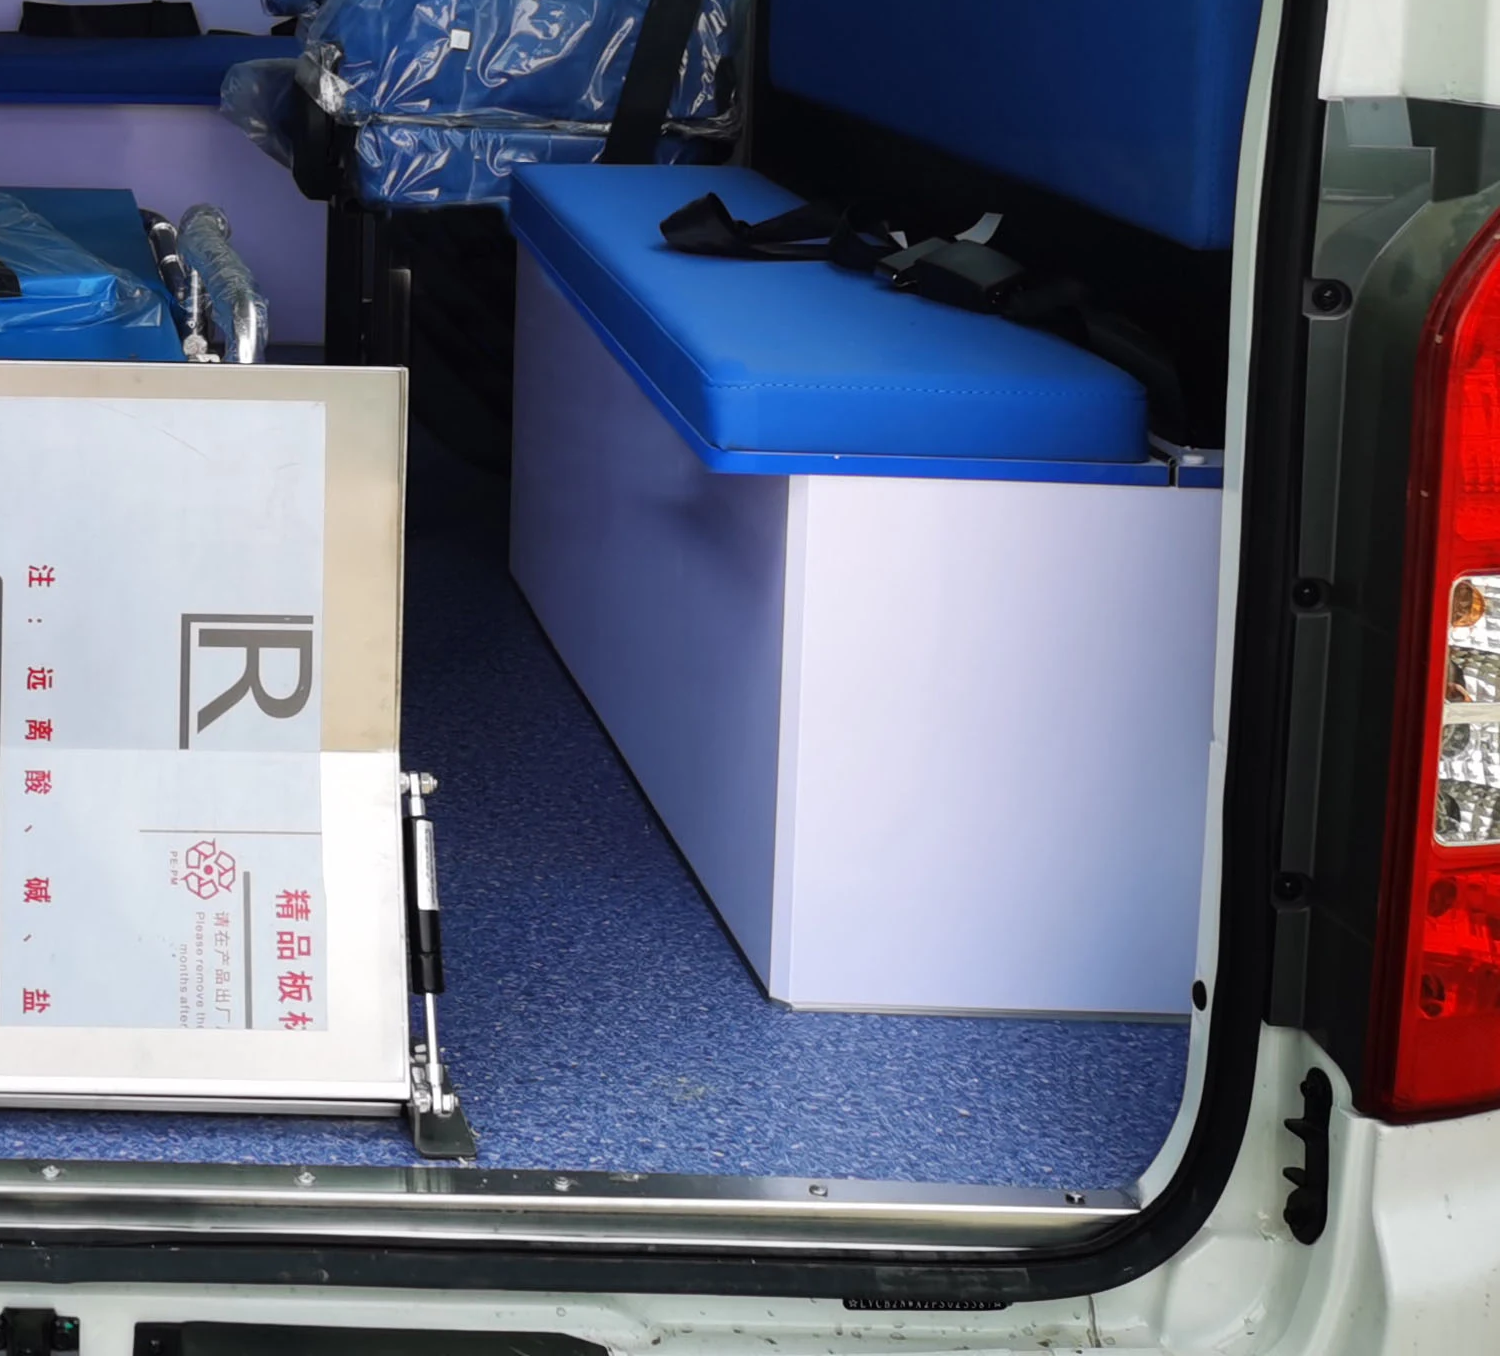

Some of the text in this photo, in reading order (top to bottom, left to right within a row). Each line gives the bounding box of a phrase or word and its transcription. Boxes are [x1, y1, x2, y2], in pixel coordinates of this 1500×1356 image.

[195, 912, 205, 955] Please
[179, 944, 189, 993] months
[195, 959, 204, 1008] remove
[213, 911, 232, 1029] 请在产品出厂
